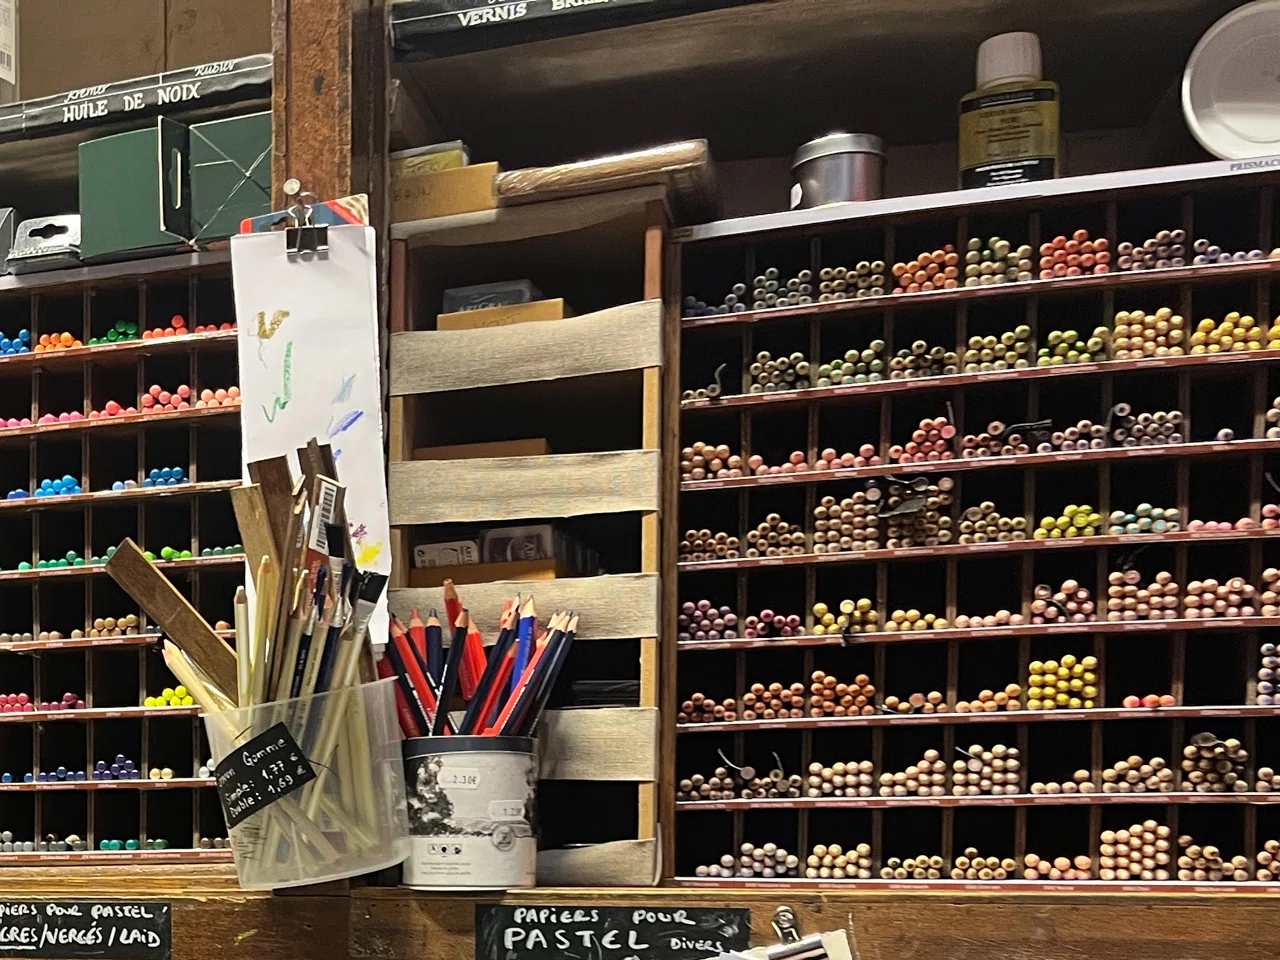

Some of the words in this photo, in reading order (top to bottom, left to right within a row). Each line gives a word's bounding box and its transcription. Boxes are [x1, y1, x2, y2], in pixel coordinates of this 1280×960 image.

[457, 3, 527, 26] VERNIS
[123, 93, 145, 111] DE
[157, 81, 202, 105] NOIX
[242, 739, 287, 767] Gomme
[45, 903, 83, 917] POUR
[90, 905, 154, 919] PASTEL
[632, 909, 696, 925] POUR
[503, 927, 649, 950] PASTEL
